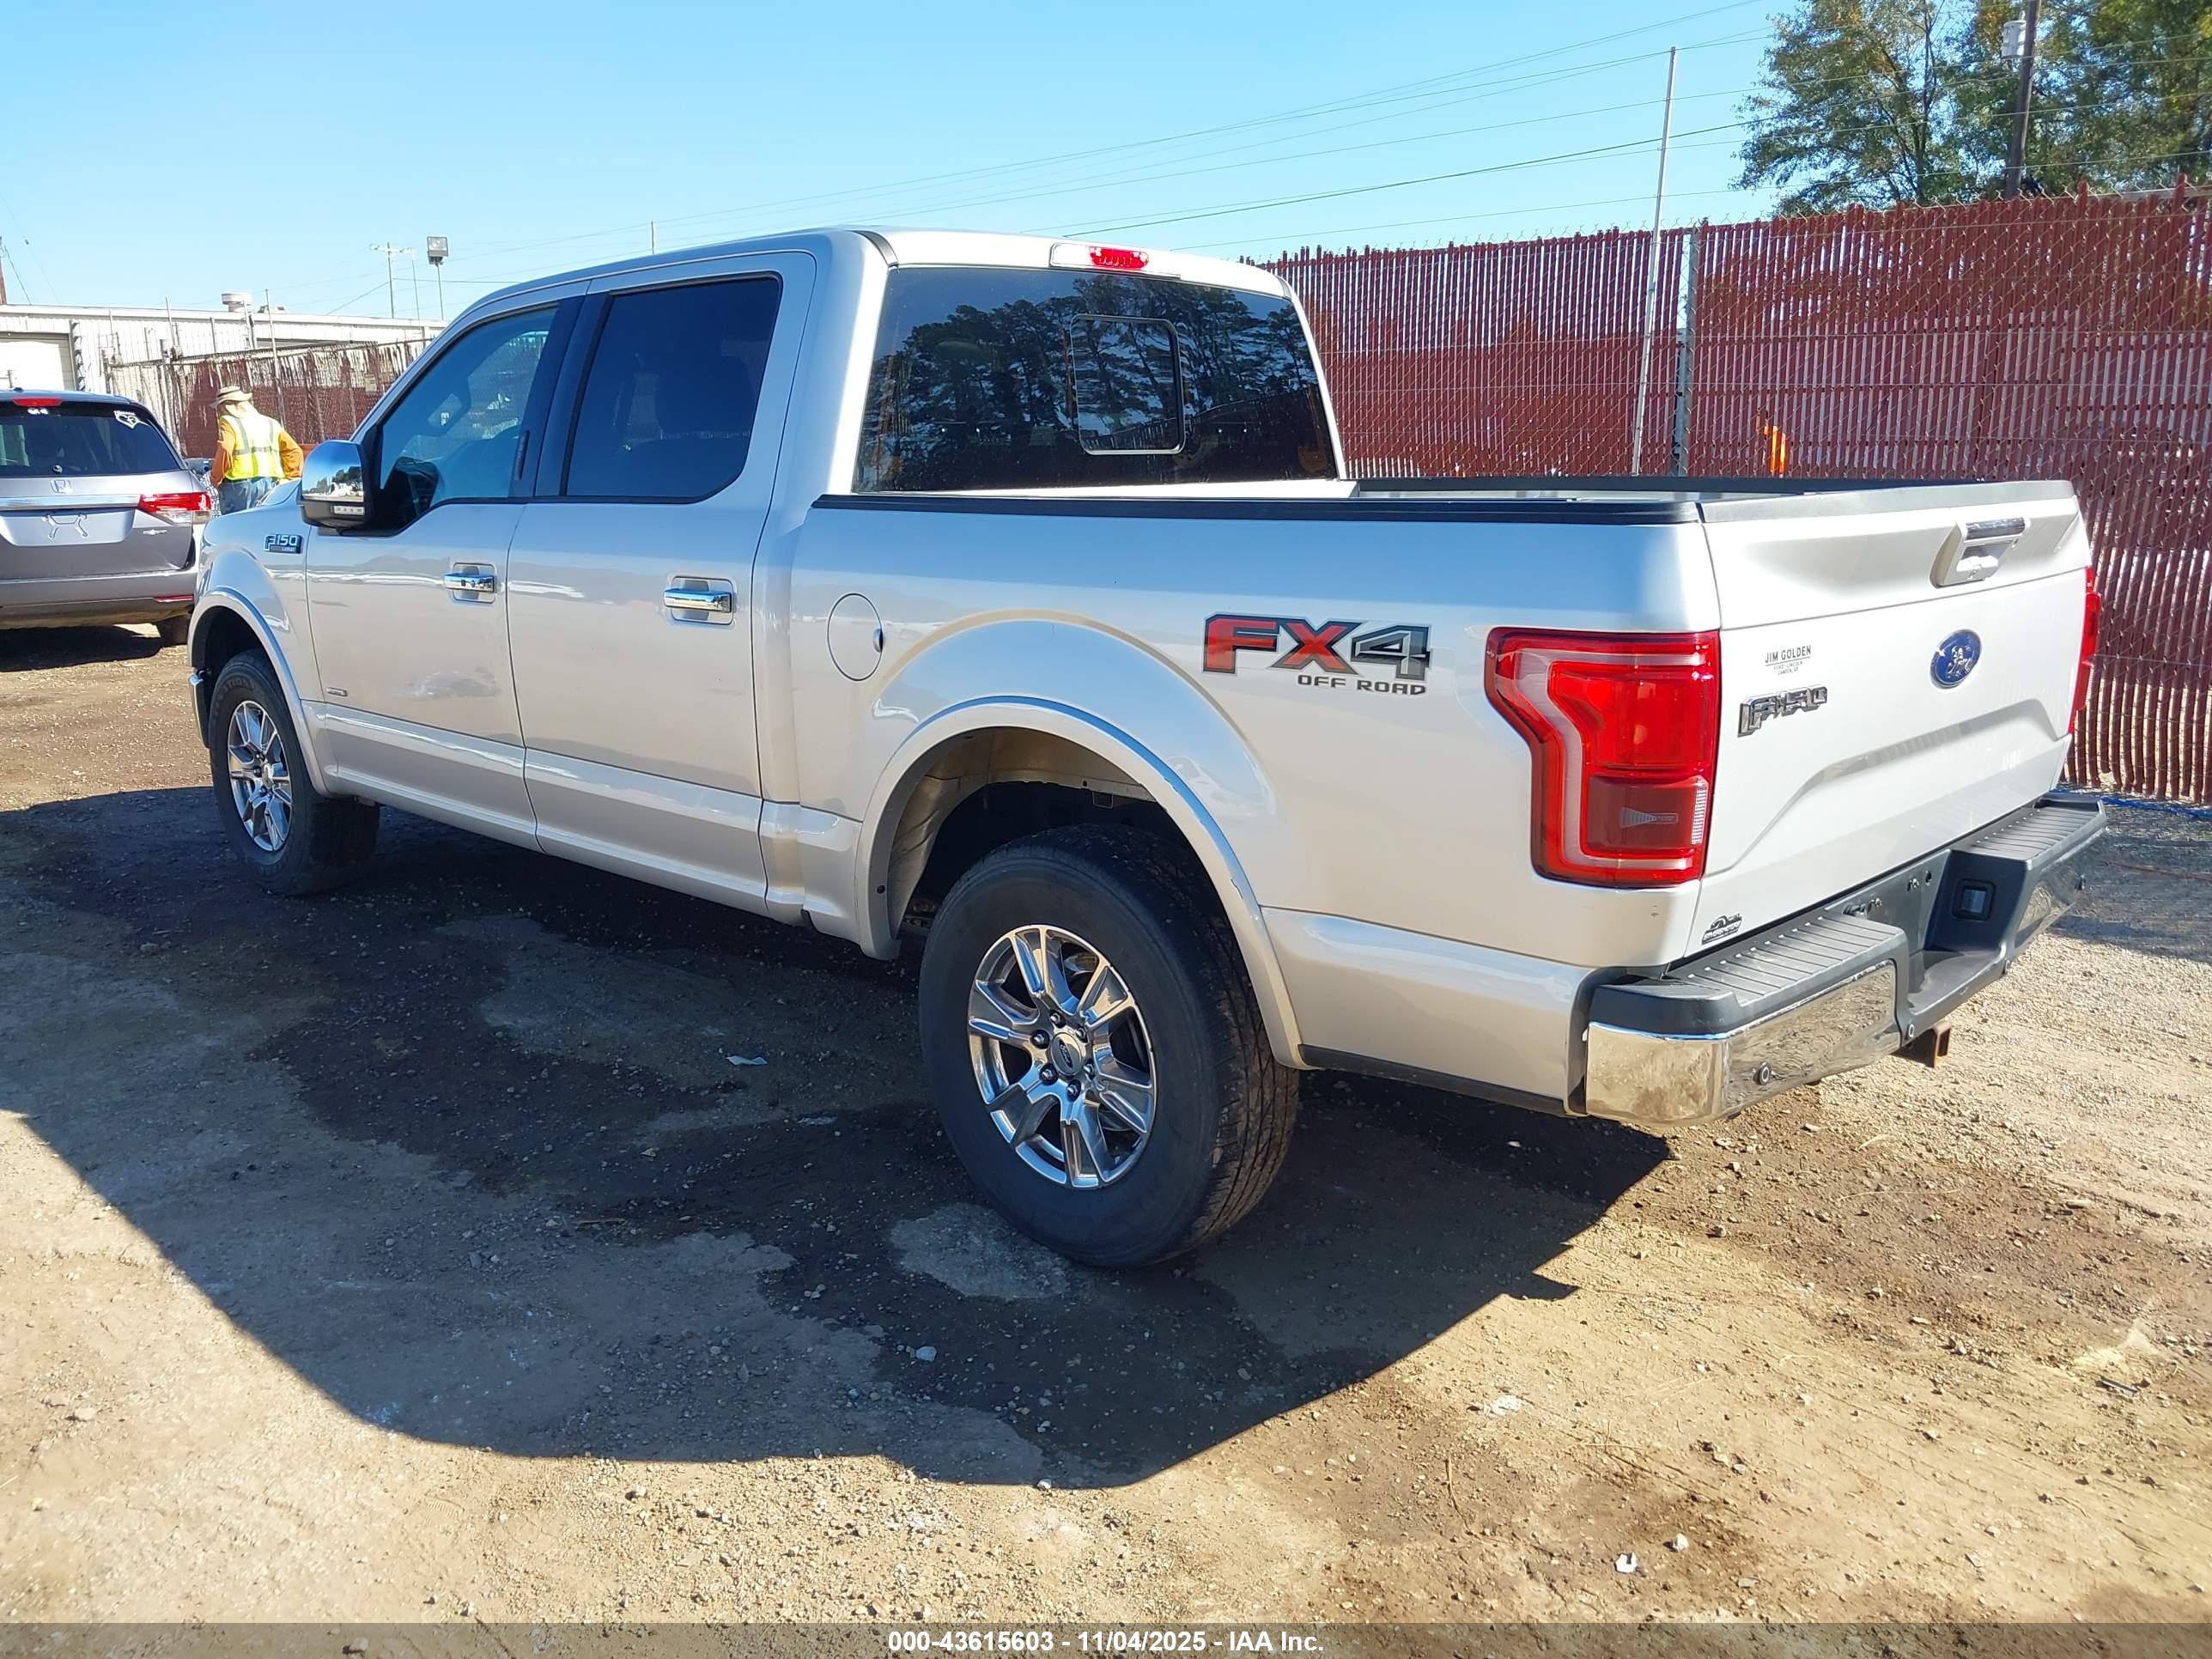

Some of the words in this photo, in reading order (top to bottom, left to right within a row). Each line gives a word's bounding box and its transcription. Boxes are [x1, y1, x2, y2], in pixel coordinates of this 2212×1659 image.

[1203, 613, 1431, 681] FX4
[1765, 651, 1778, 664] JIM
[1781, 645, 1812, 660] GOLDEN
[1298, 674, 1346, 689] OFF
[1357, 679, 1426, 696] ROAD
